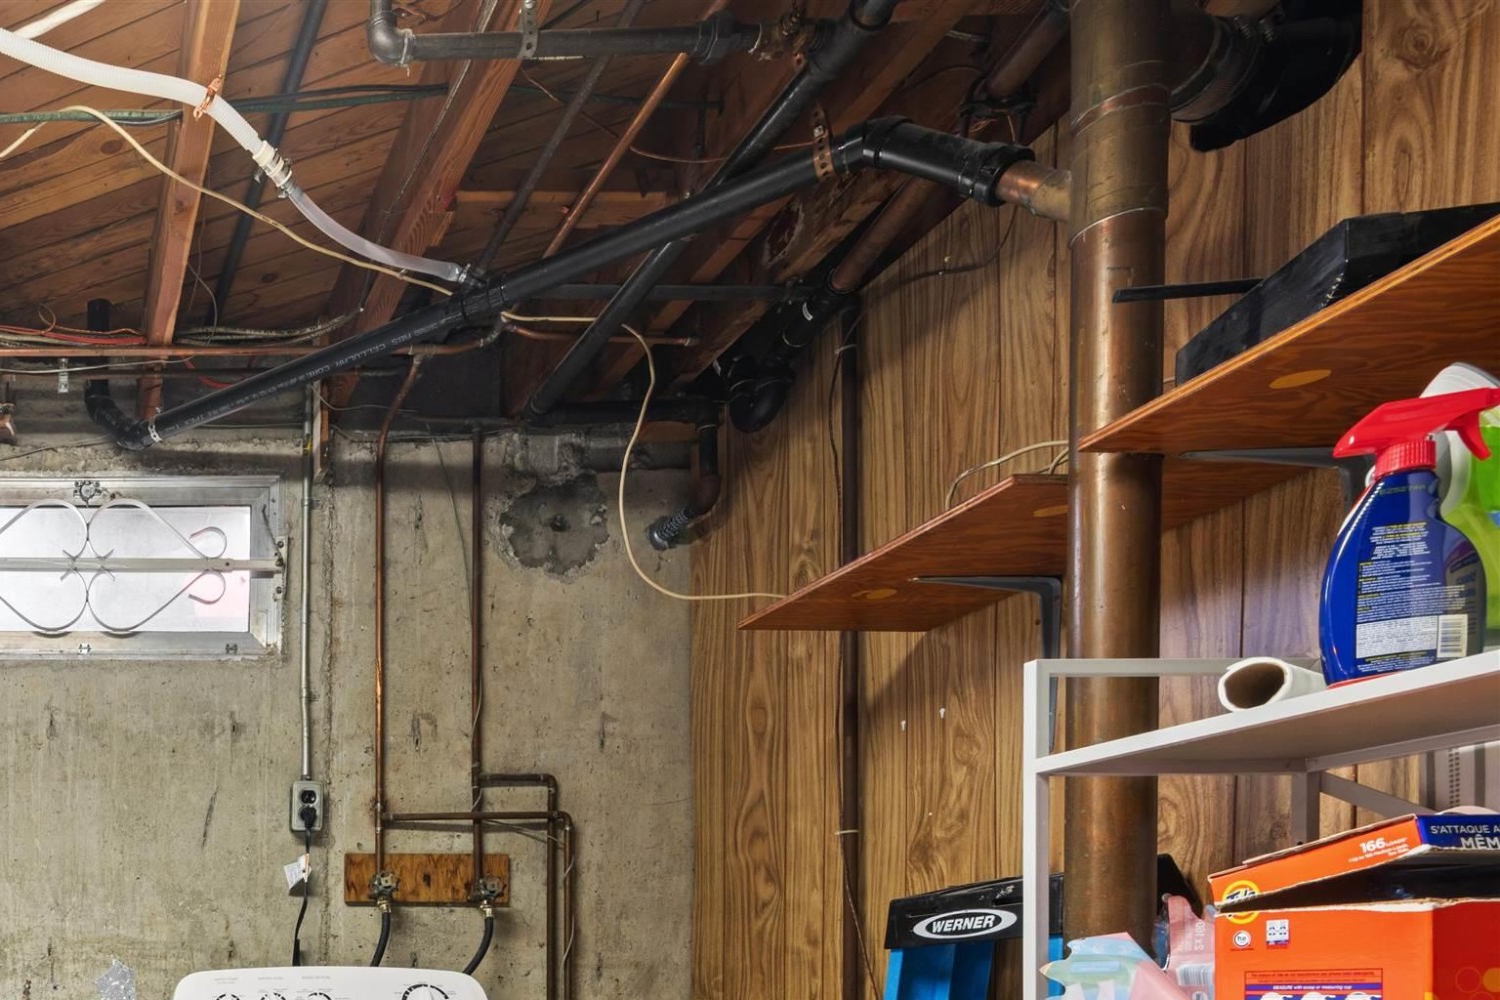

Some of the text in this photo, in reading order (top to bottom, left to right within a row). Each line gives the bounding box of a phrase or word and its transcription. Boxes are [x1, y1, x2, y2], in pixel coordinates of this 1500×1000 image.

[336, 343, 387, 369] CELLULAR
[1430, 825, 1491, 834] S'ATTAQUE
[1360, 837, 1386, 853] 166
[932, 916, 995, 933] WERNER
